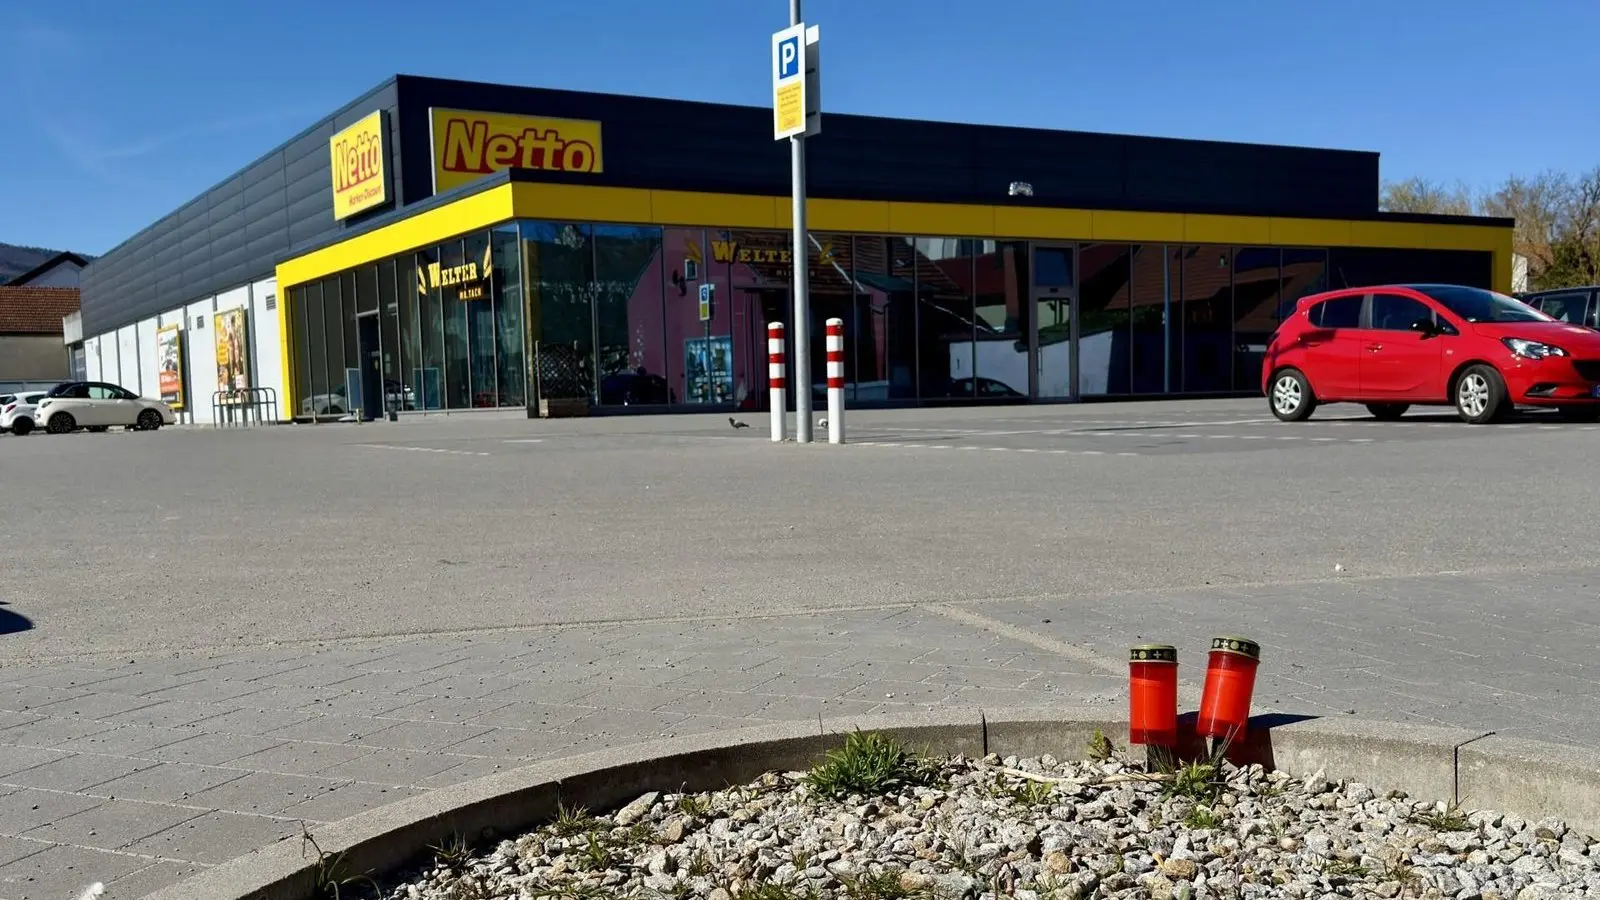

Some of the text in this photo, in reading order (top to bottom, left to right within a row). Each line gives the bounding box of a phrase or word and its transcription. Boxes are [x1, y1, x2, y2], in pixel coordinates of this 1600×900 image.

[782, 42, 796, 75] P
[335, 131, 381, 193] Netto
[443, 119, 594, 174] Netto
[711, 240, 794, 265] WELTE
